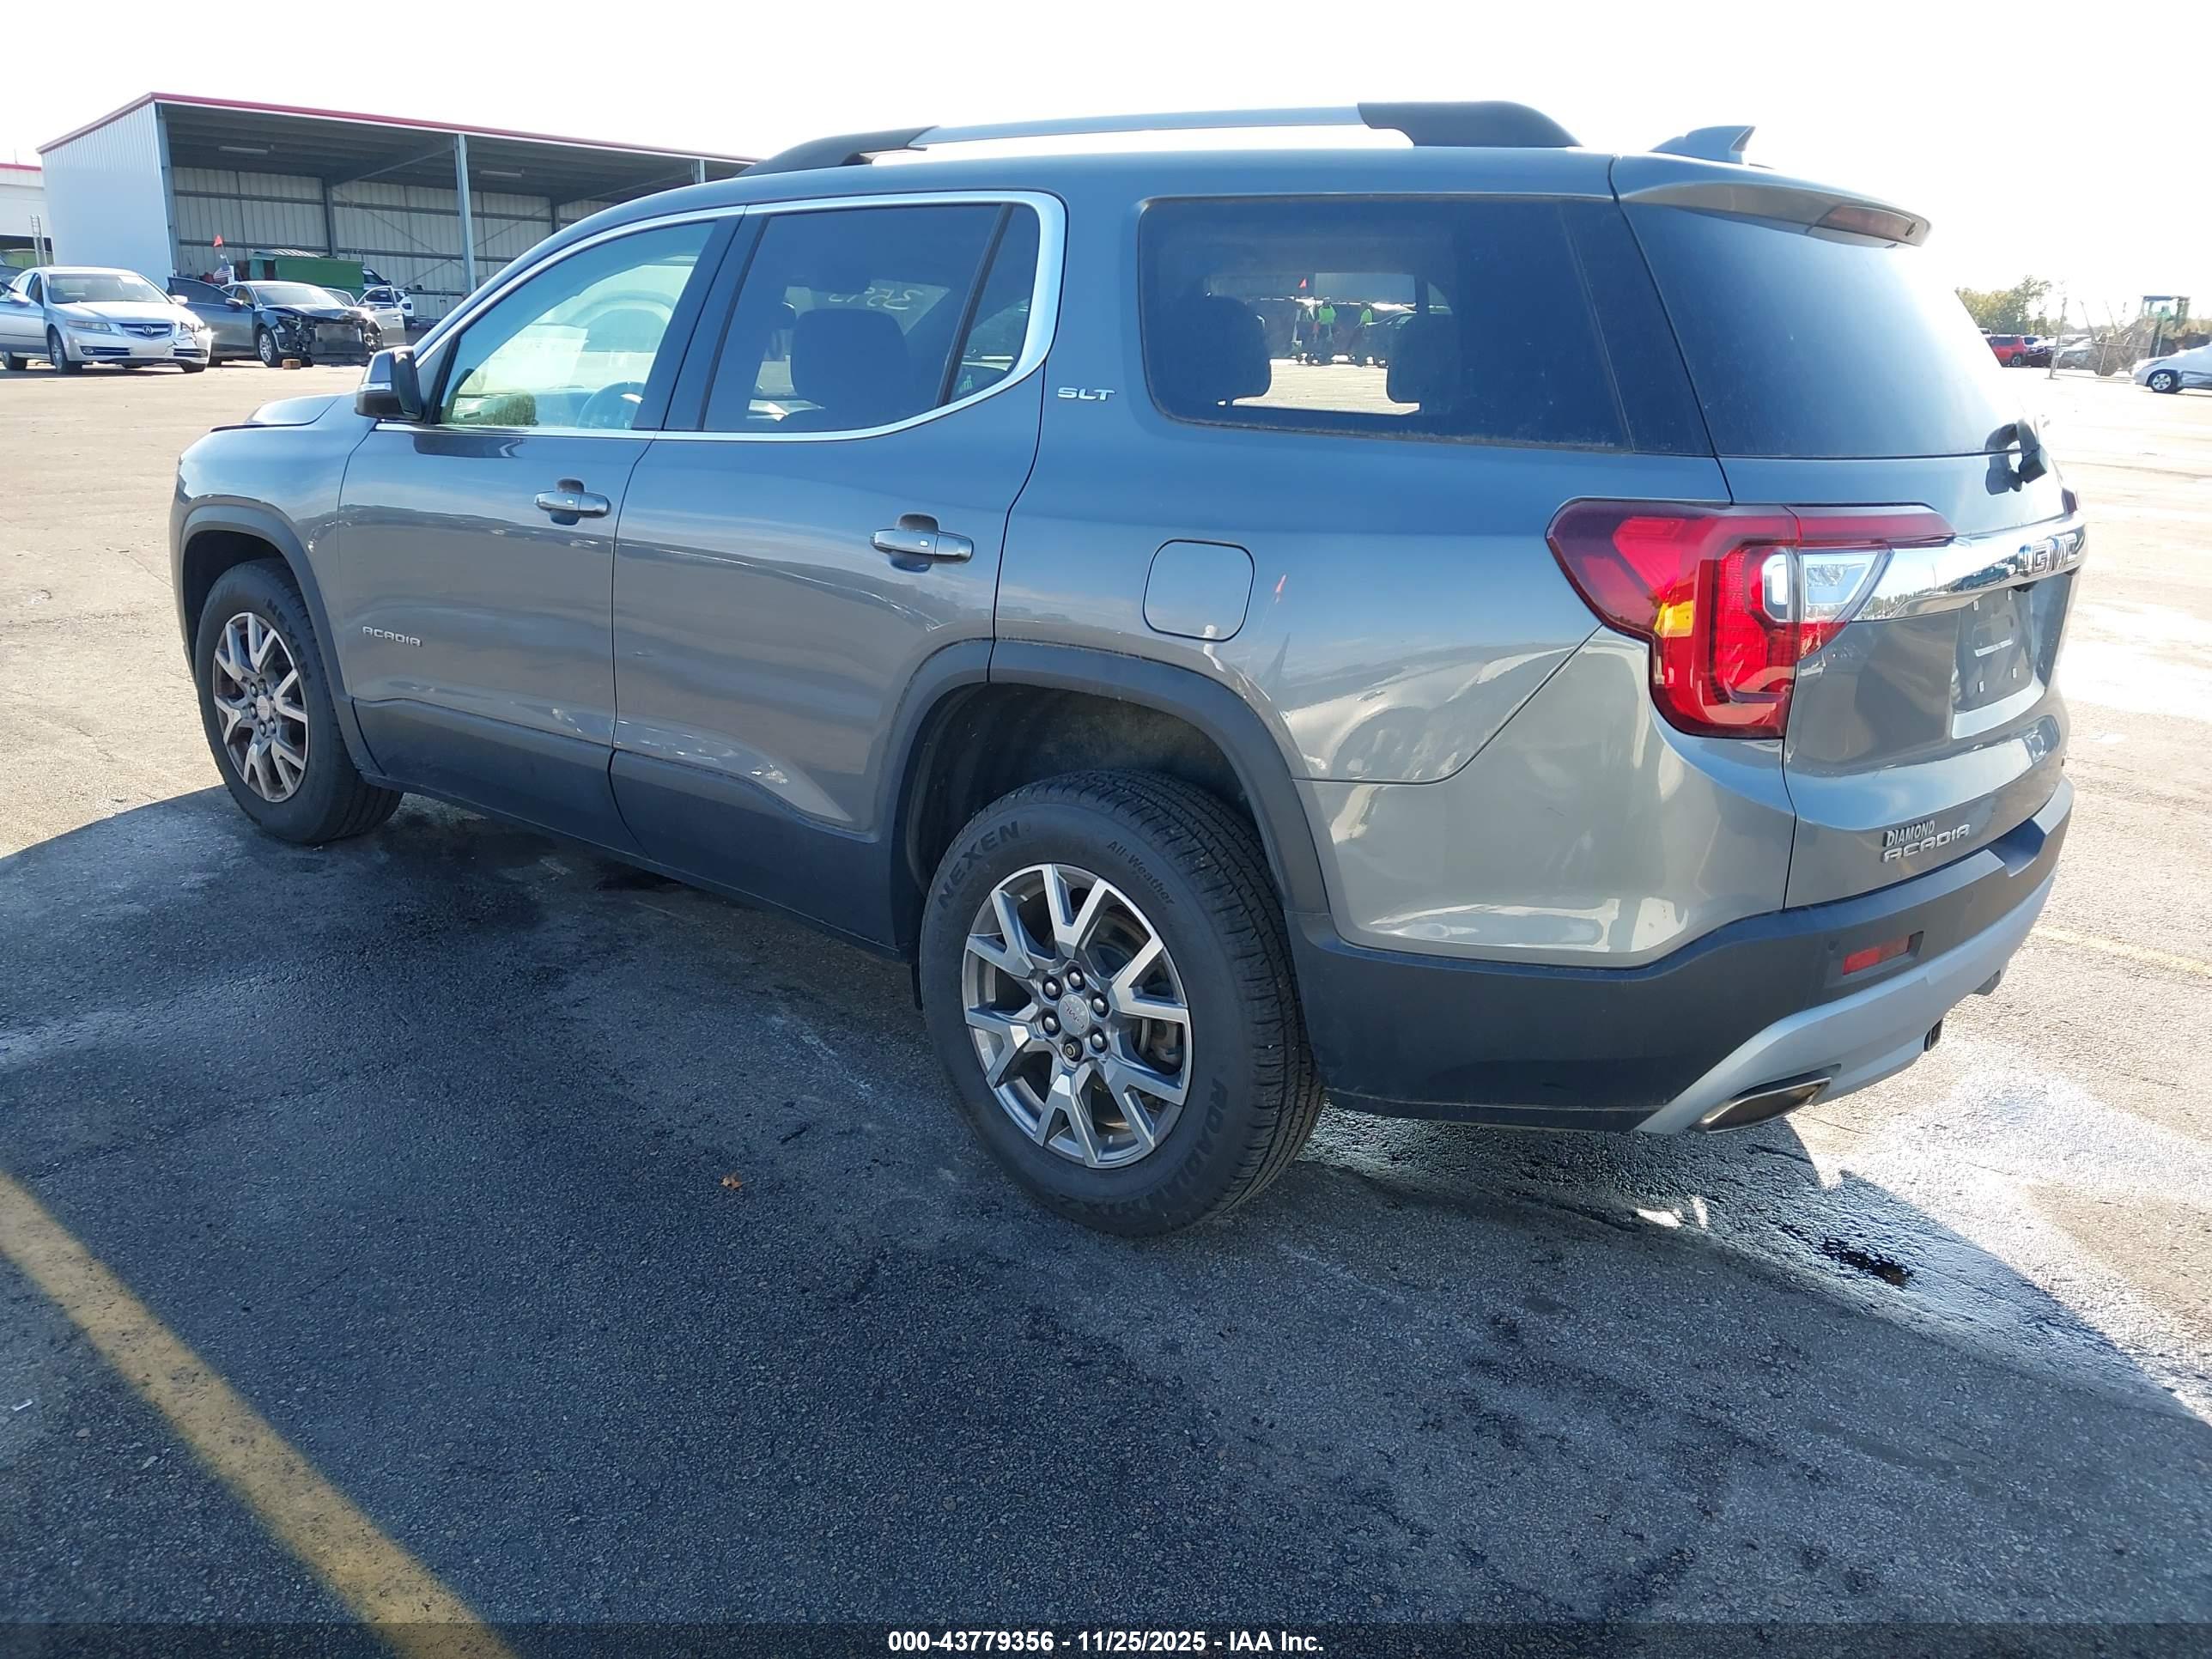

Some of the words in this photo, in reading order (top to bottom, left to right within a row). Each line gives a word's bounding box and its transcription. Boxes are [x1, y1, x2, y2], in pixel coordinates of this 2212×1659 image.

[1057, 386, 1116, 402] SLT
[2018, 532, 2084, 577] GMC
[362, 625, 422, 647] ACADIA
[1881, 823, 1972, 864] ACADIA
[1884, 819, 1936, 848] DIAMOND
[937, 820, 1021, 908] NEXEN
[1105, 840, 1176, 905] All-Weather
